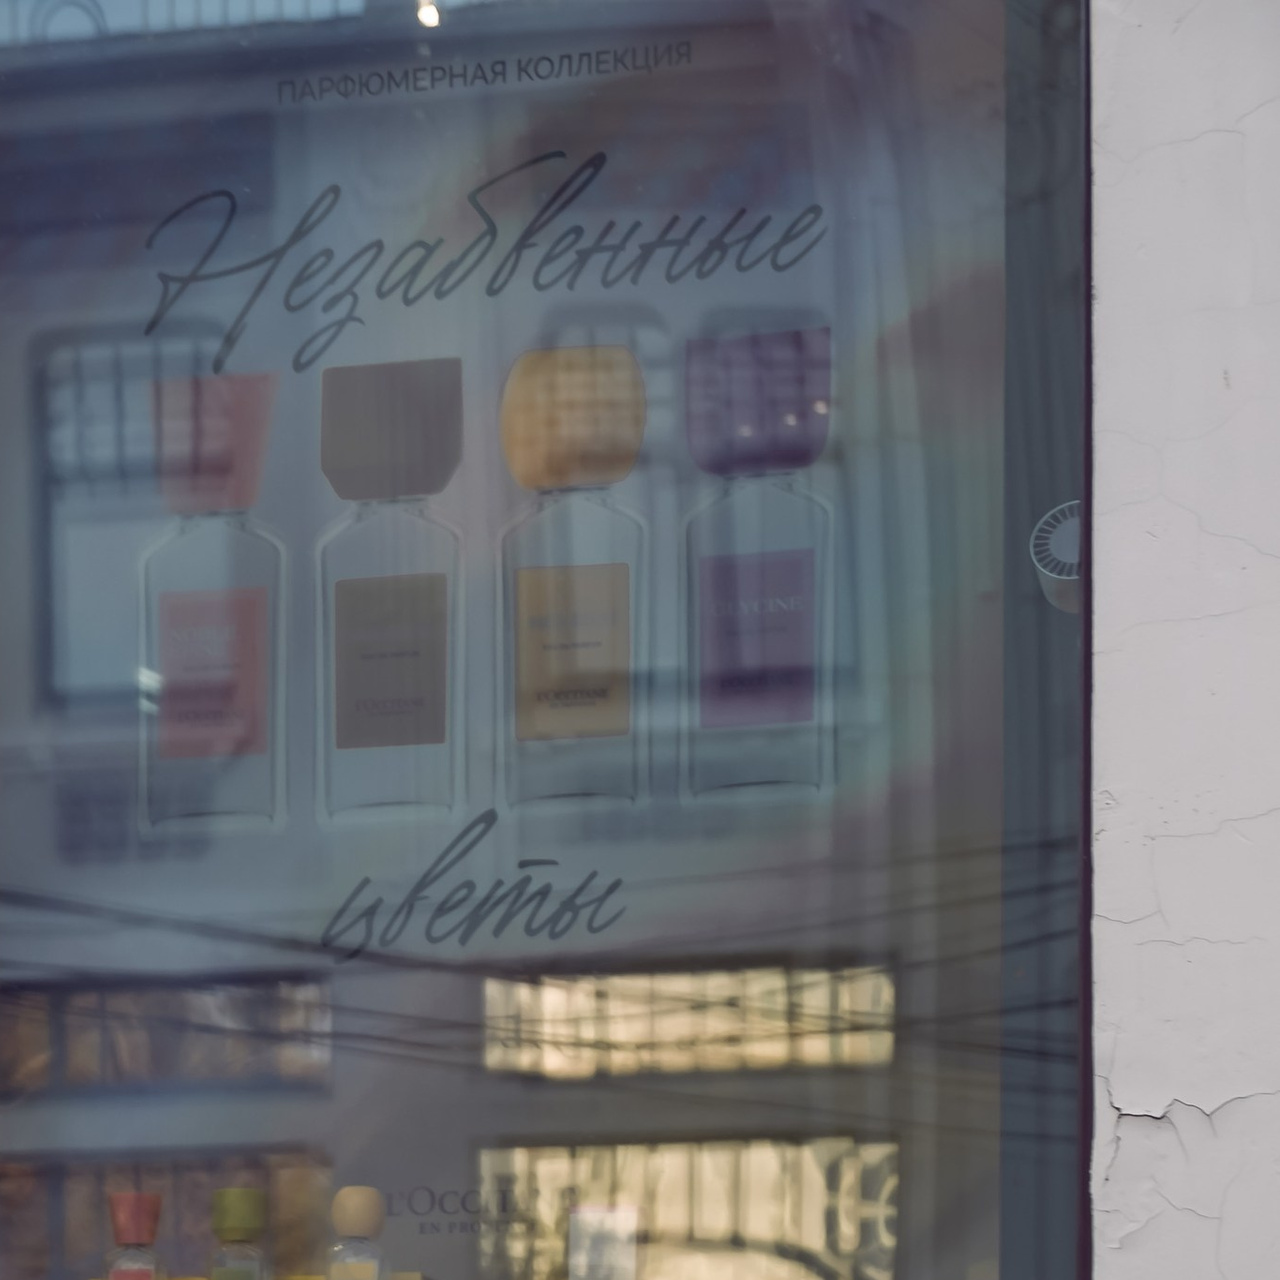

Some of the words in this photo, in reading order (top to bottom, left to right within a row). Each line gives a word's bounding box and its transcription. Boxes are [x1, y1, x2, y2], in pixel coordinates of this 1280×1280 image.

[277, 59, 507, 105] ПАРФЮМЕРНАЯ
[517, 40, 693, 82] КОЛЛЕКЦИЯ
[144, 150, 828, 375] Незабвенные
[321, 807, 627, 966] цветы
